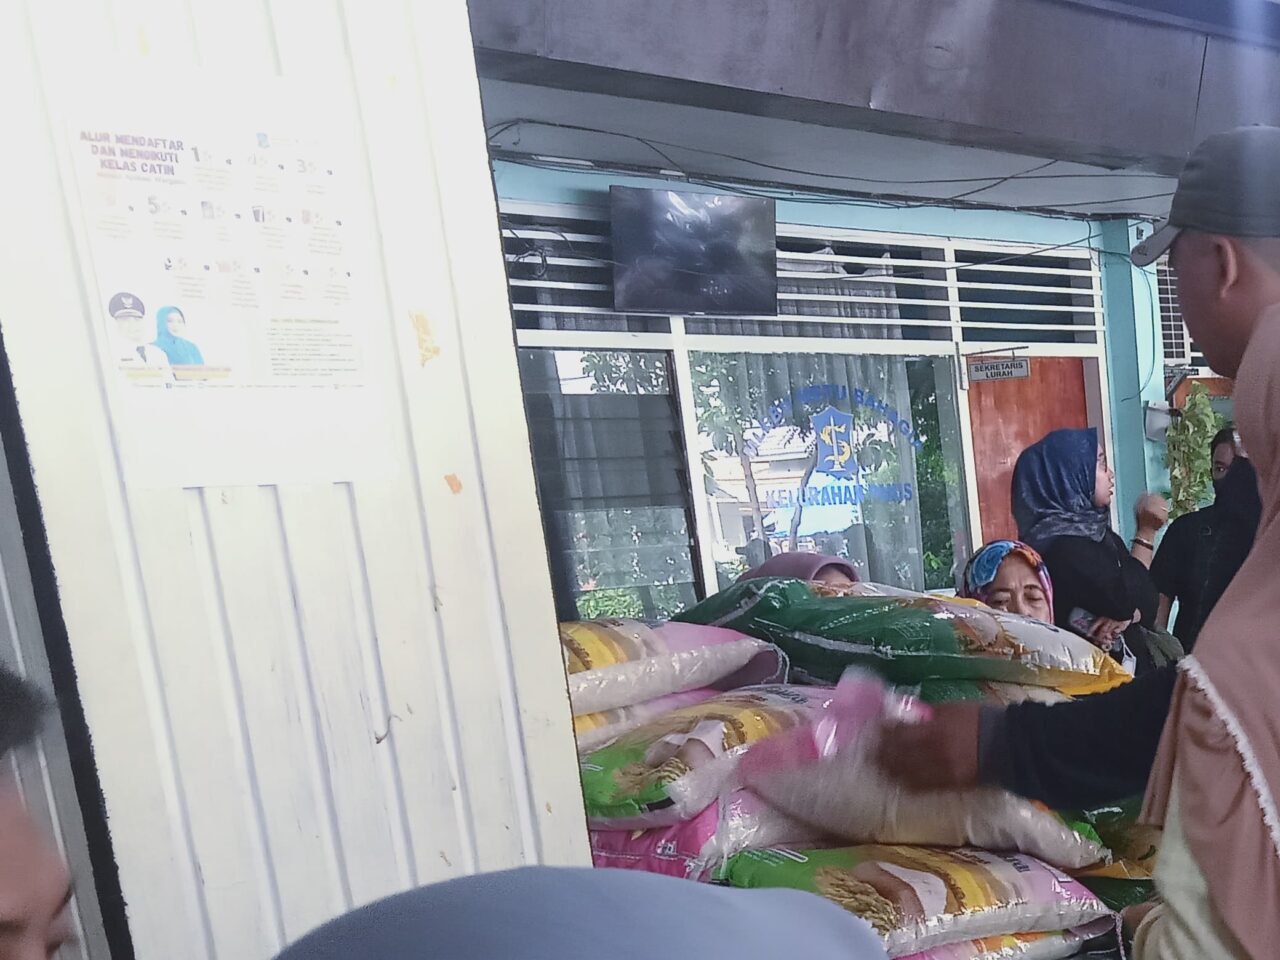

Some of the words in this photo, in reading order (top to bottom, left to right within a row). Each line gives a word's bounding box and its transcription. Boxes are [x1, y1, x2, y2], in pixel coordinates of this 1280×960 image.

[80, 131, 111, 143] ALUR
[114, 134, 184, 151] MENDAFTAR
[91, 144, 116, 157] DAN
[100, 159, 137, 172] KELAS
[140, 162, 175, 176] CATIN
[974, 362, 1023, 373] SEKRETARIS
[985, 370, 1013, 379] LURAH
